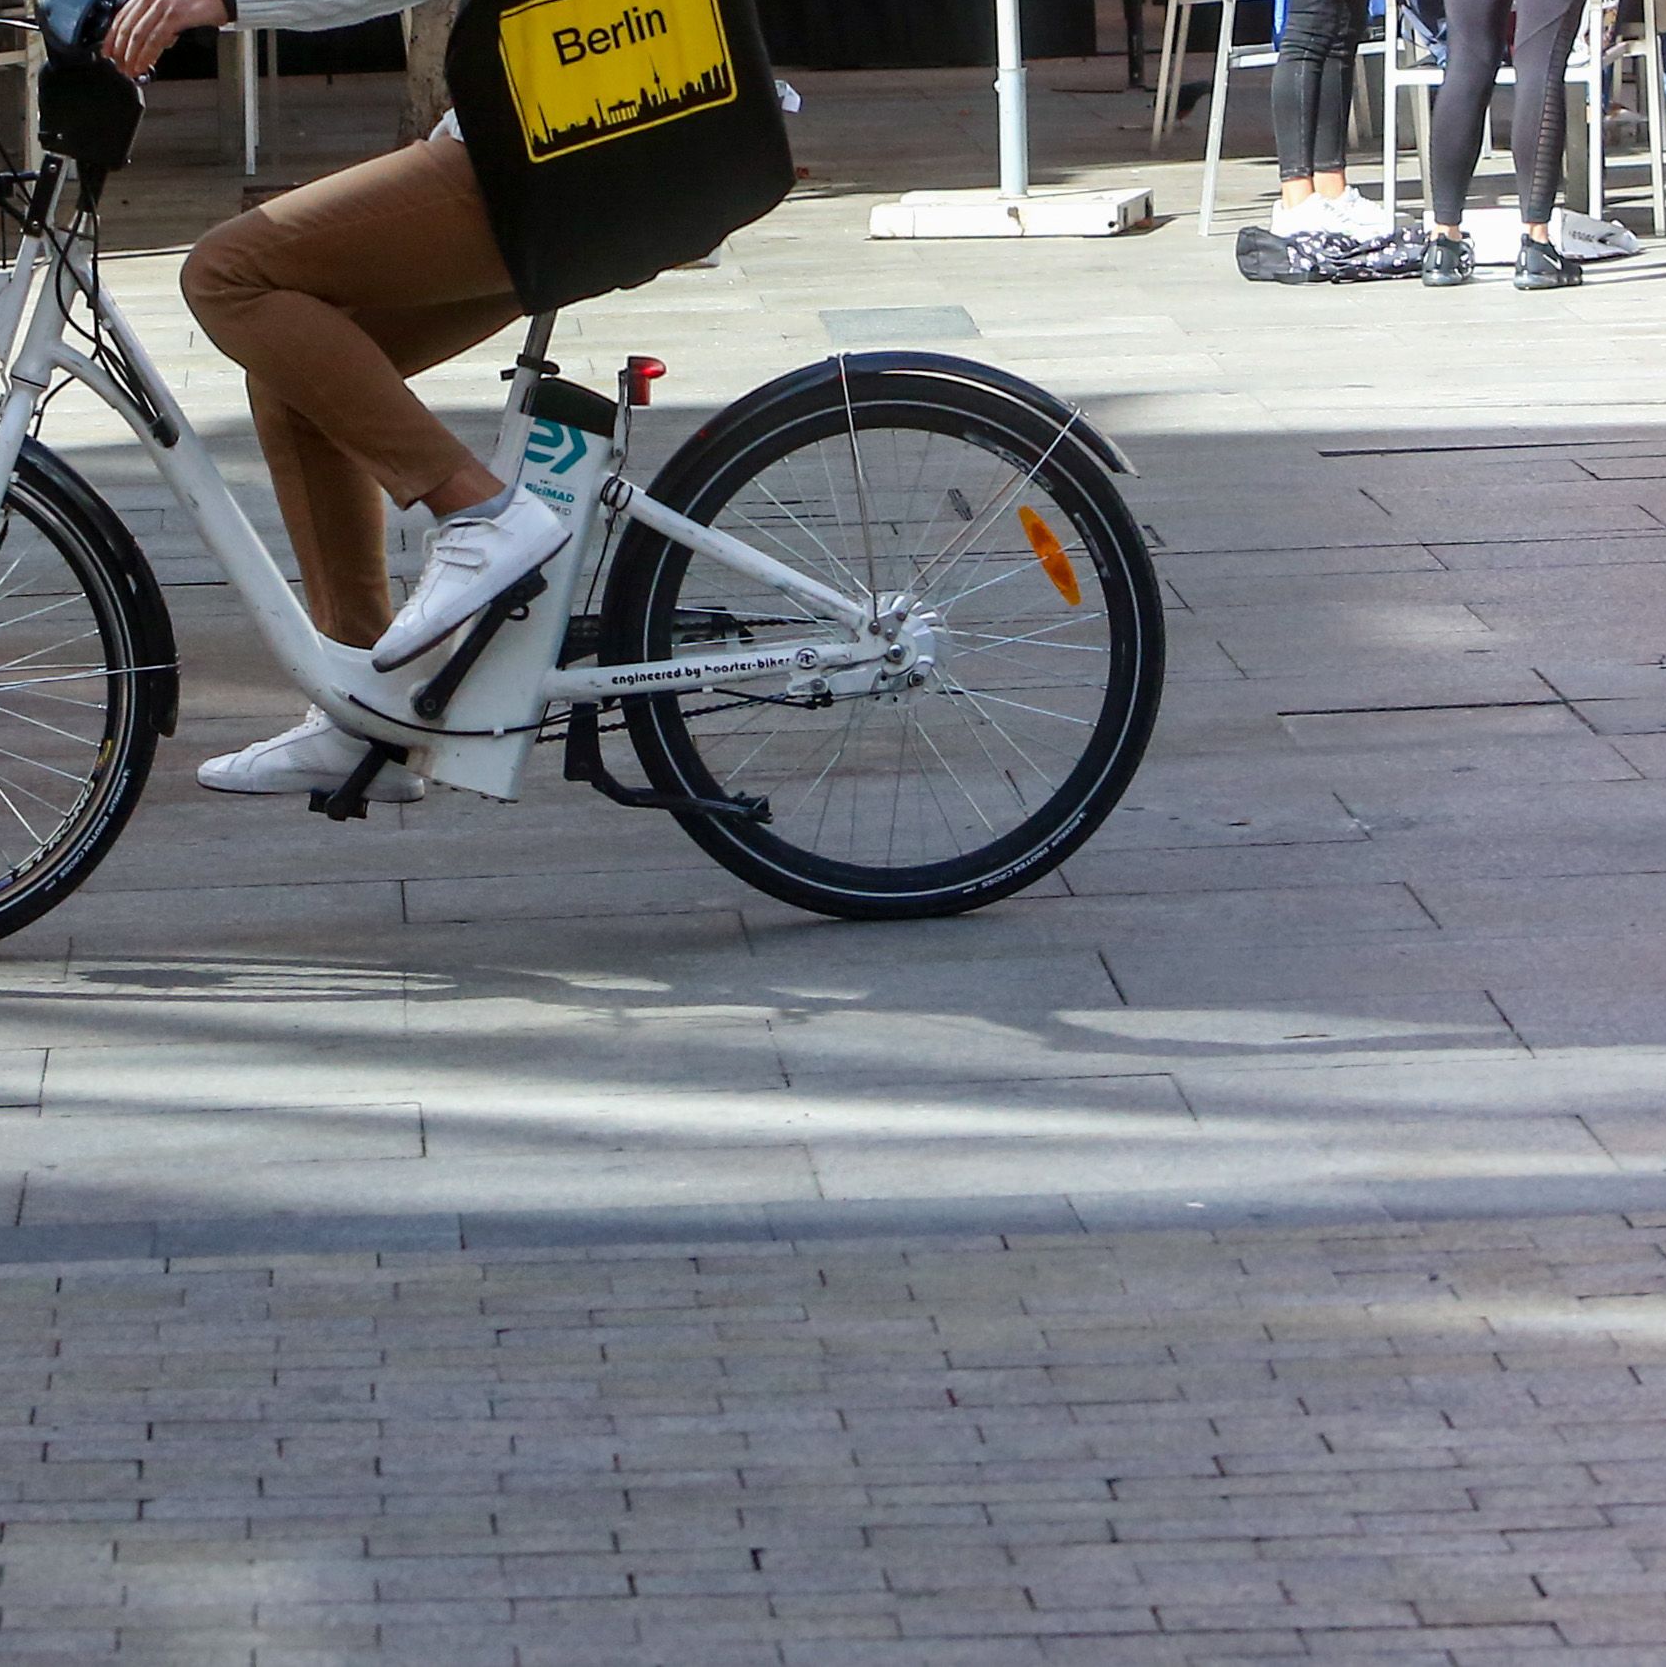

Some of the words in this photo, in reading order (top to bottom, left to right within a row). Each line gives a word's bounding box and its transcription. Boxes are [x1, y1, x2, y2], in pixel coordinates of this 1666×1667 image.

[552, 5, 668, 67] Berlin
[611, 668, 681, 685] engineered
[685, 665, 701, 680] by
